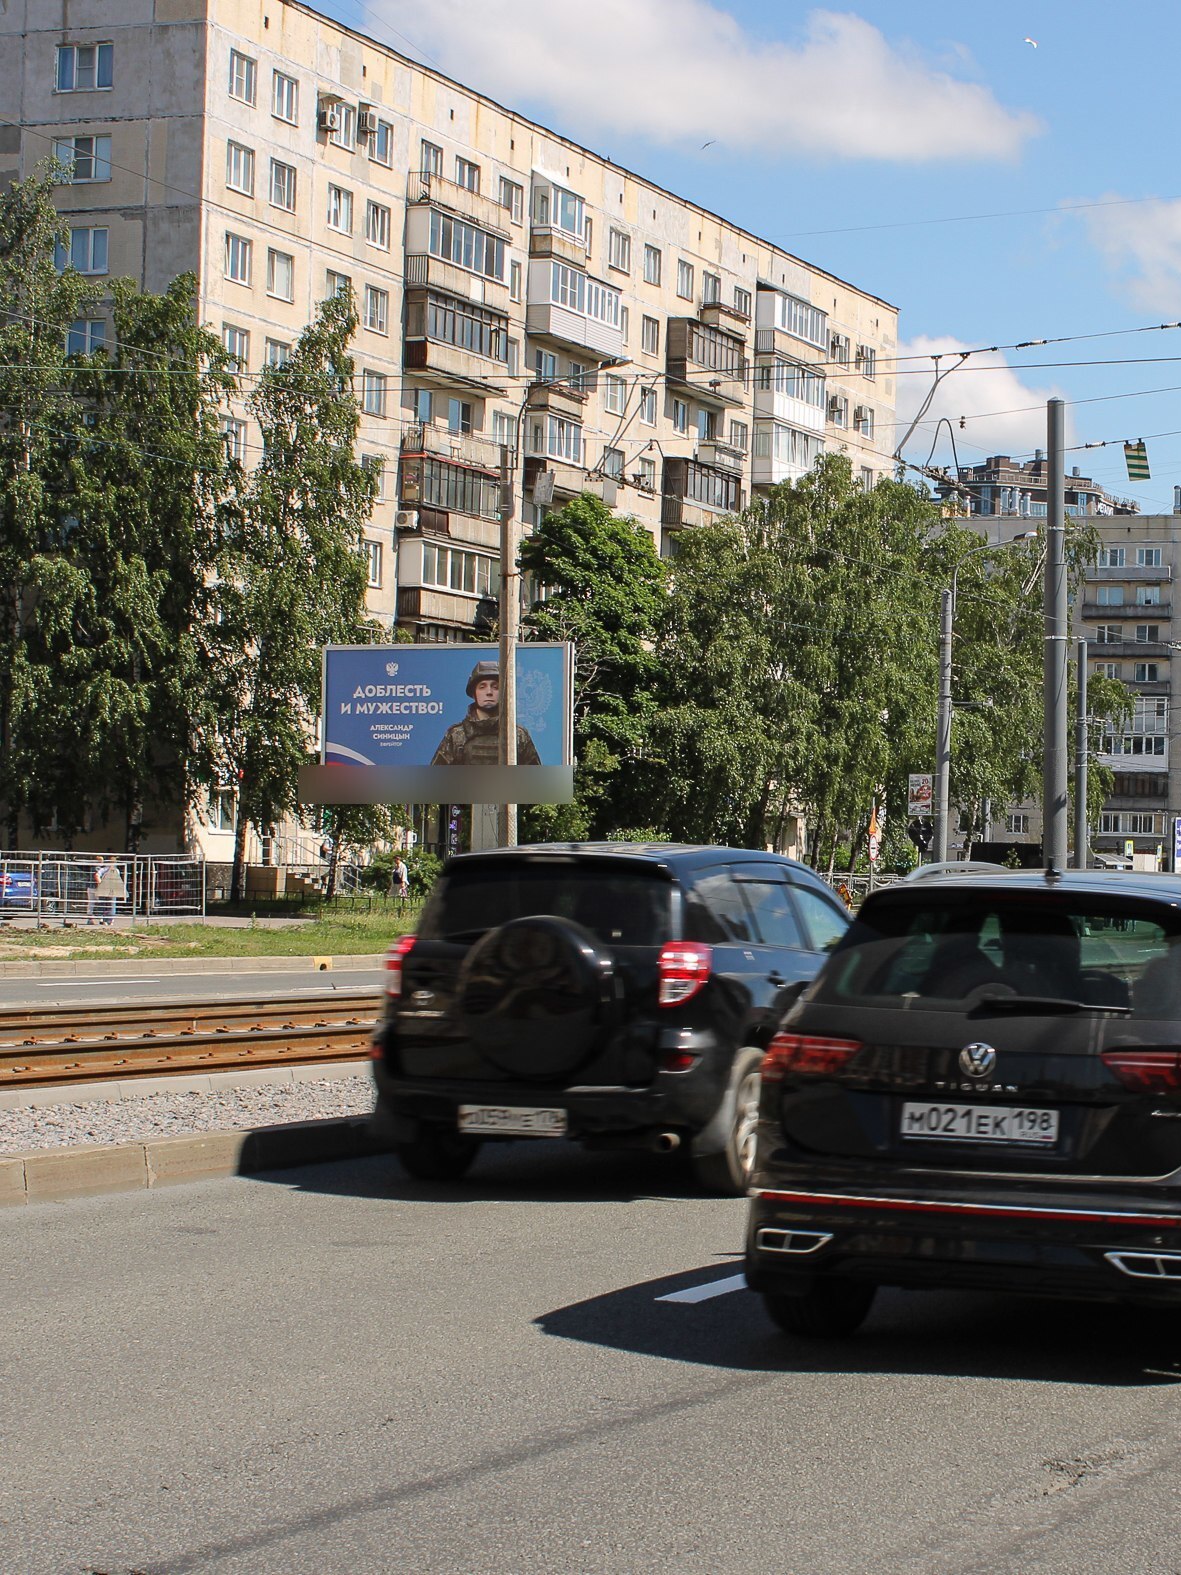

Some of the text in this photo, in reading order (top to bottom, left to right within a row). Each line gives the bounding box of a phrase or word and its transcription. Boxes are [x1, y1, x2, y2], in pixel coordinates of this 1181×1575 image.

[353, 685, 431, 698] ДОБЛЕСТЬ
[341, 702, 443, 714] И МУЖЕСТВО!
[907, 1107, 1051, 1136] М021ЕК 198
